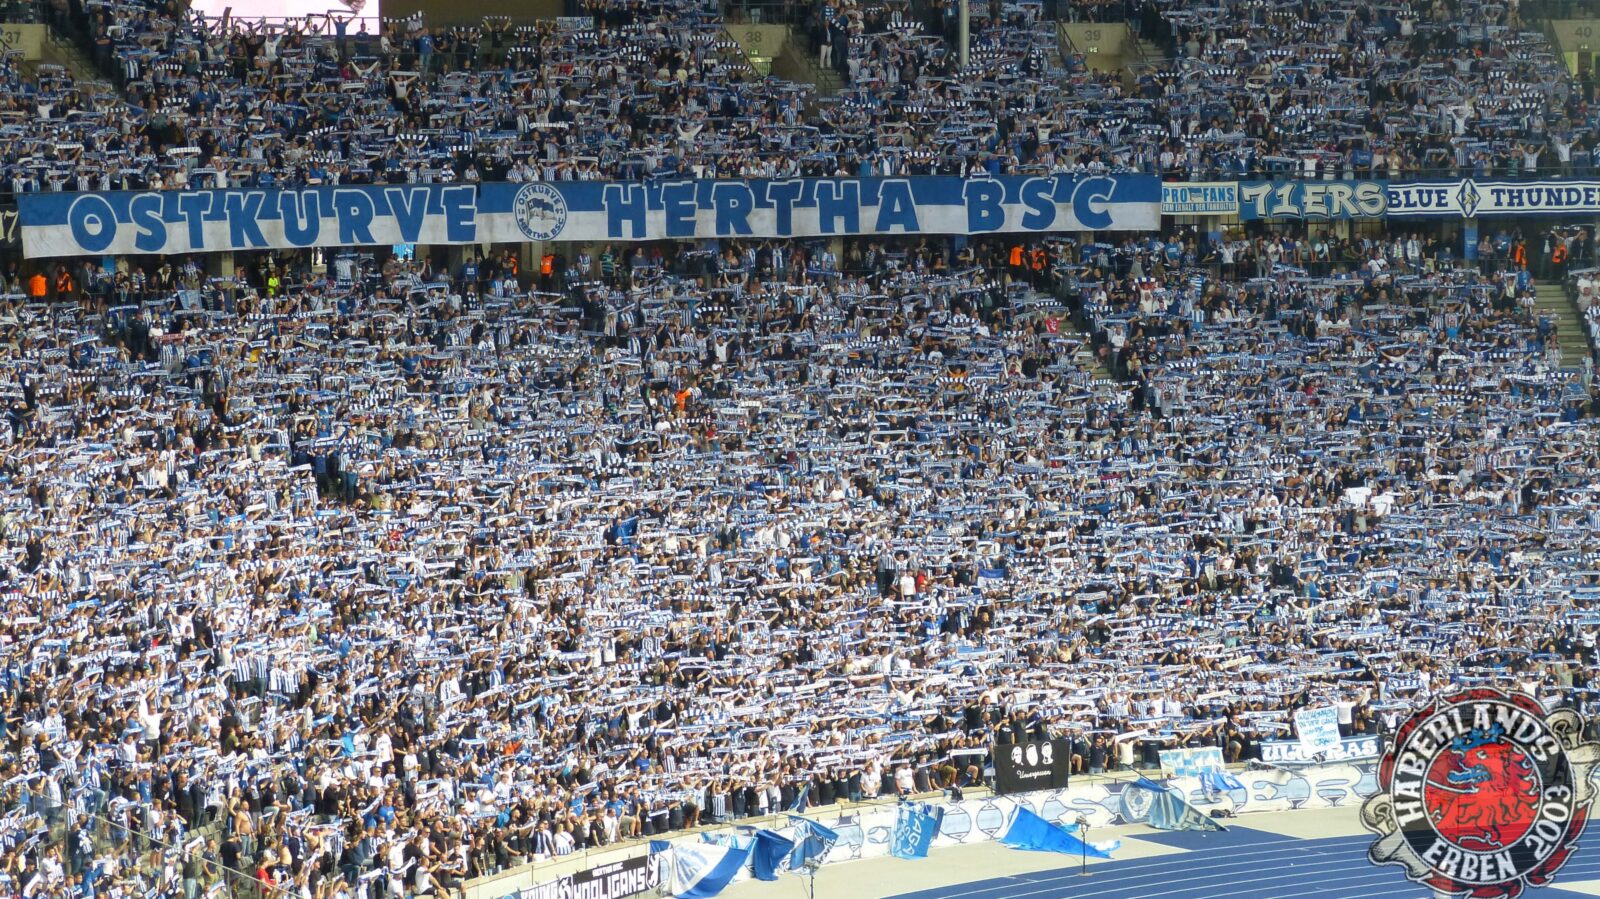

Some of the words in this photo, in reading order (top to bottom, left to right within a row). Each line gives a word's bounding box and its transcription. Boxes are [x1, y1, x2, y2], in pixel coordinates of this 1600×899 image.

[5, 31, 21, 44] 37
[745, 31, 761, 43] 38
[1085, 30, 1101, 41] 39
[1574, 25, 1593, 38] 40
[518, 186, 561, 205] OSTKURVE
[1162, 188, 1188, 203] PRO
[1203, 187, 1234, 202] FANS
[1241, 182, 1388, 218] 71ERS
[1388, 188, 1449, 208] BLUE
[1491, 187, 1600, 207] THUNDE
[67, 185, 478, 253] OSTKURVE
[602, 178, 921, 240] HERTHA
[962, 176, 1118, 234] BSC
[518, 218, 551, 238] HERTHA
[573, 867, 646, 899] HOOLIGANS
